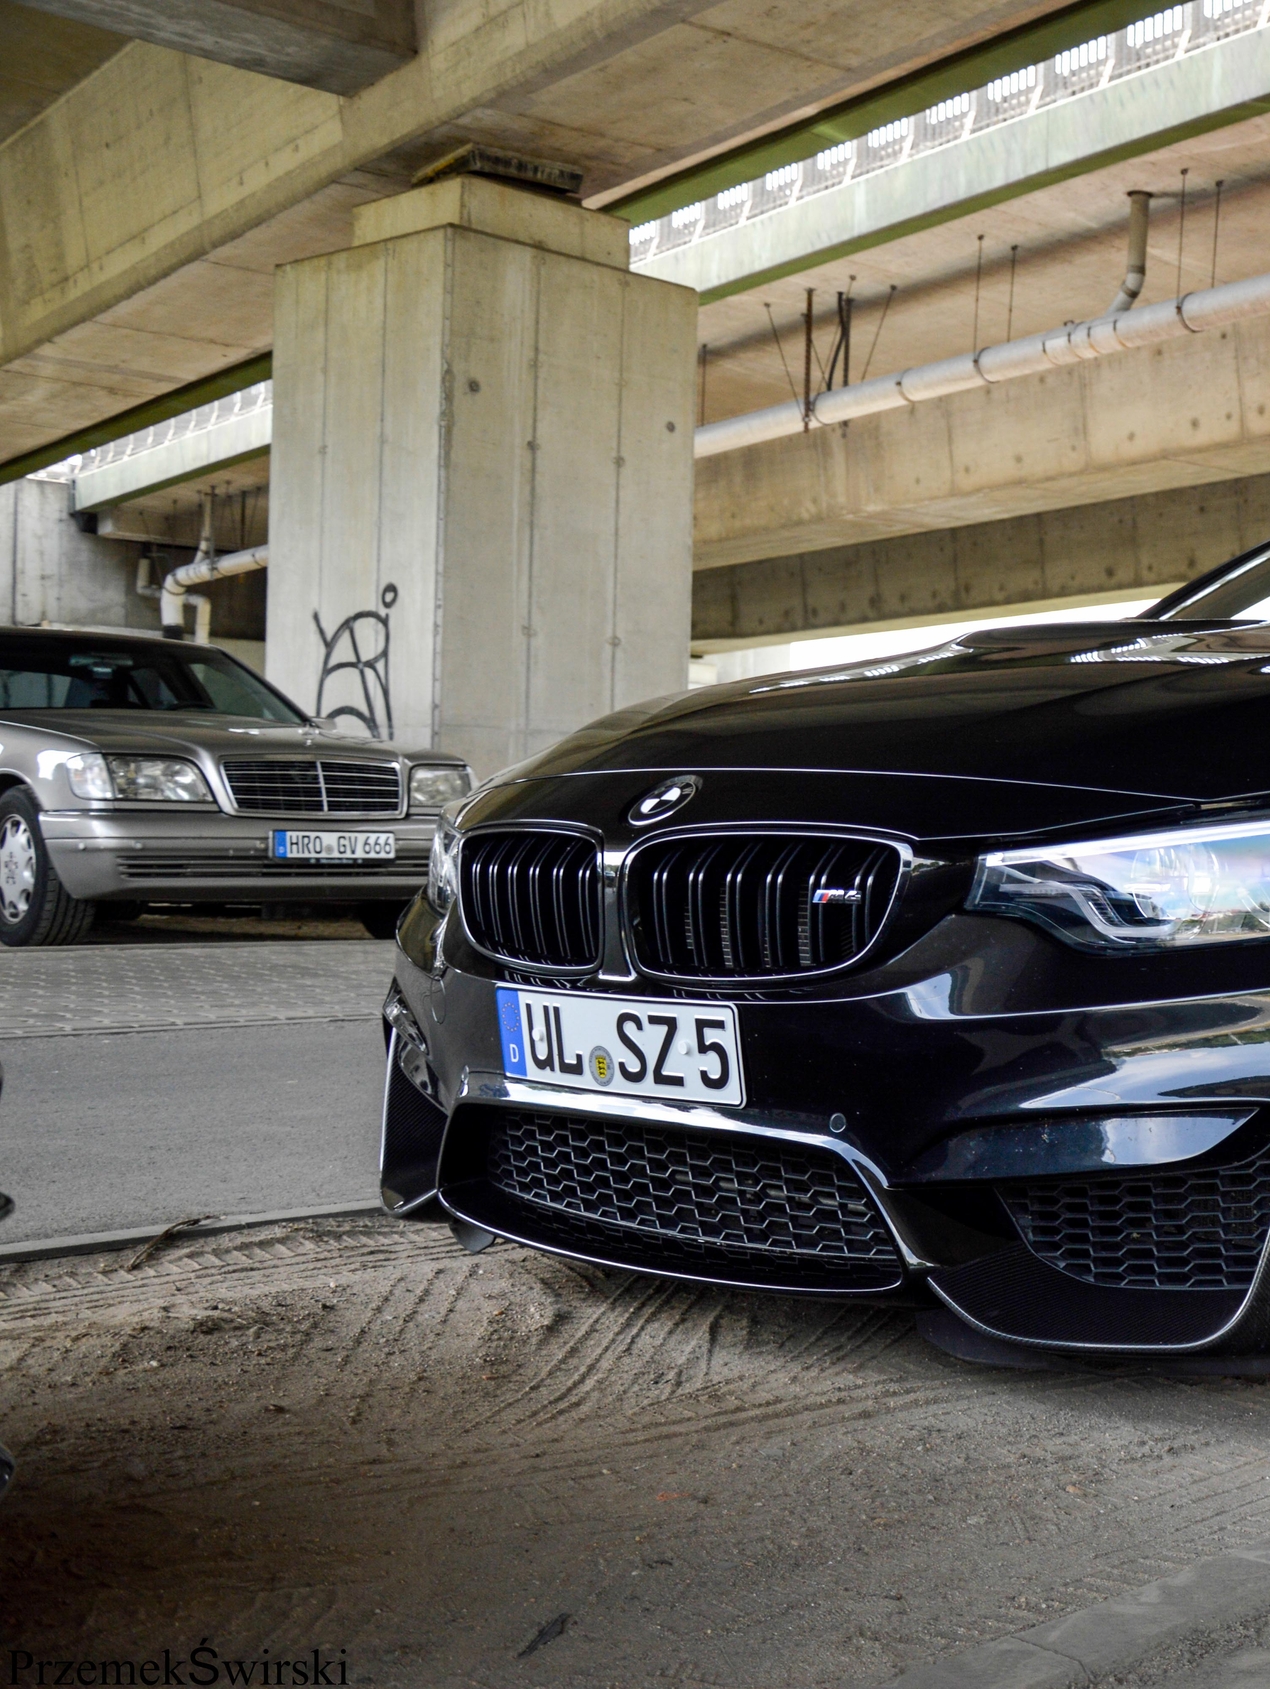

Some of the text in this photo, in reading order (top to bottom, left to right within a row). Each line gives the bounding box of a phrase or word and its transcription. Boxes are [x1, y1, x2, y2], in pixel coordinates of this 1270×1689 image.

[289, 835, 392, 855] HRO GV 666
[509, 1044, 519, 1063] D
[525, 1001, 584, 1076] UL
[616, 1010, 685, 1087] SZ
[694, 1016, 730, 1090] 5
